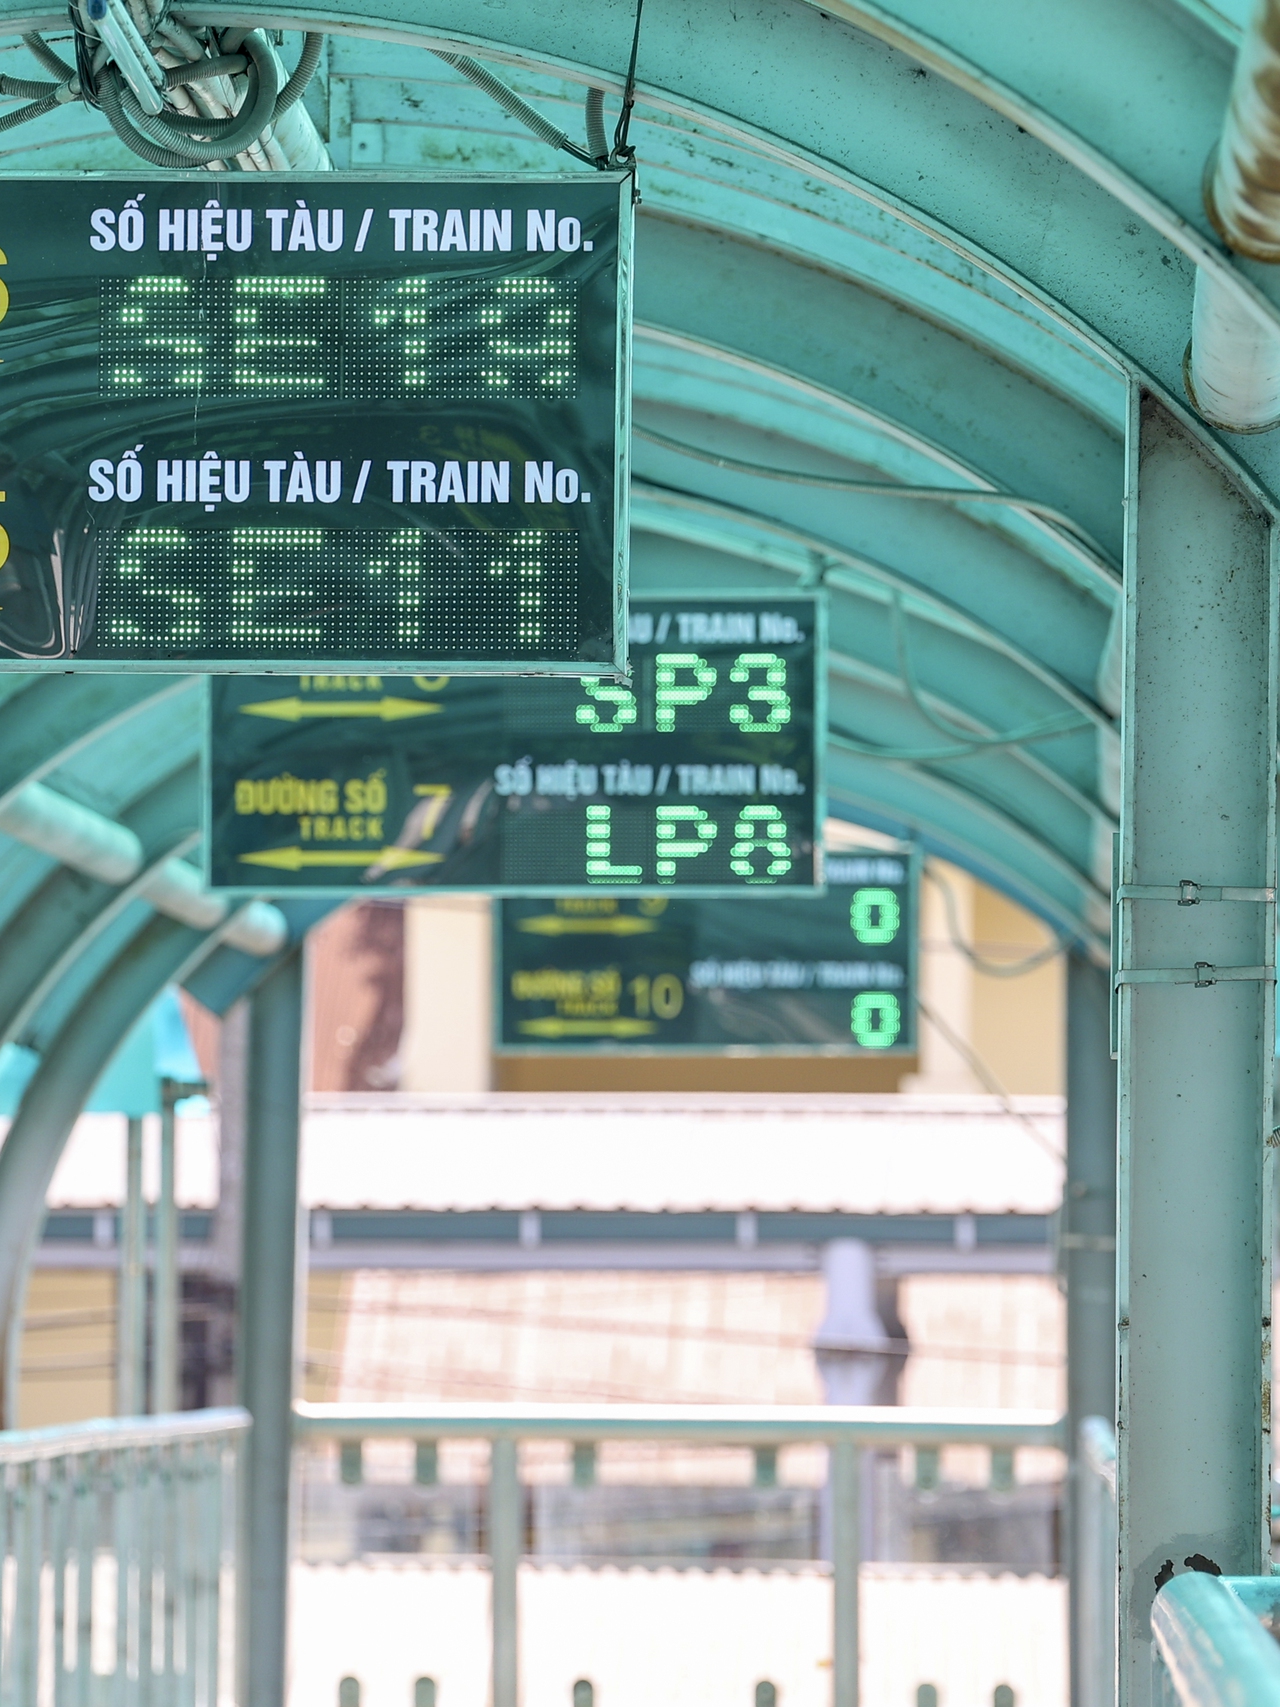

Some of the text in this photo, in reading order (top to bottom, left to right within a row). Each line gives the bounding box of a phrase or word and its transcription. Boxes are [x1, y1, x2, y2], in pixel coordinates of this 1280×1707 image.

[89, 194, 146, 253] SỐ
[158, 201, 253, 261] HIỆU
[266, 200, 344, 252] TÀU
[389, 208, 513, 253] TRAIN
[526, 208, 594, 253] No.
[88, 444, 145, 503] SỐ
[157, 451, 251, 512] HIỆU
[264, 451, 342, 503] TÀU
[386, 460, 510, 504] TRAIN
[524, 460, 591, 504] No.
[111, 528, 542, 641] SE11
[676, 613, 756, 644] TRAIN
[576, 653, 790, 732] SP3
[344, 768, 387, 815] SỐ
[494, 755, 533, 796] SỐ
[600, 759, 654, 796] TÀU
[675, 764, 756, 796] TRAIN
[299, 815, 384, 841] TRACK
[413, 784, 452, 840] 7
[586, 805, 791, 884] LP8
[850, 888, 900, 946] 0
[628, 974, 684, 1019] 10
[851, 991, 901, 1049] 0
